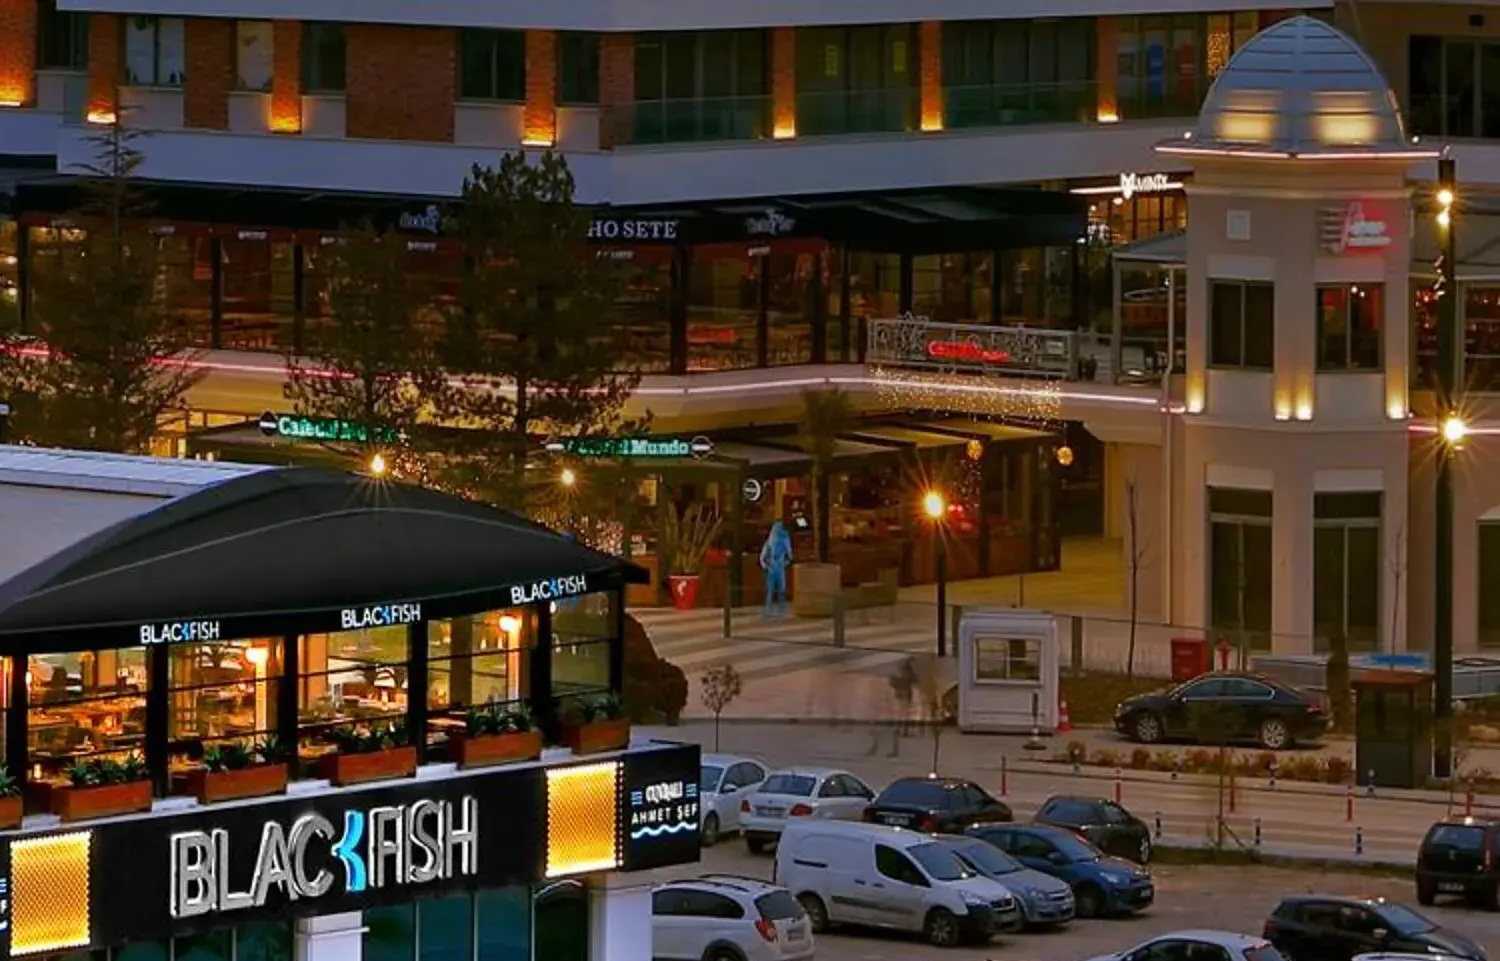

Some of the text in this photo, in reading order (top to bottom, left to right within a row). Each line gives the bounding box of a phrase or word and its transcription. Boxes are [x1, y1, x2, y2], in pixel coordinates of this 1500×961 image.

[623, 220, 678, 239] SETE
[631, 439, 689, 455] Mundo
[511, 575, 587, 604] BLACKFISH
[341, 603, 421, 629] BLACKFISH
[140, 620, 220, 644] BLACKFISH
[631, 807, 671, 824] AHMET
[170, 796, 479, 919] BLACKFISH
